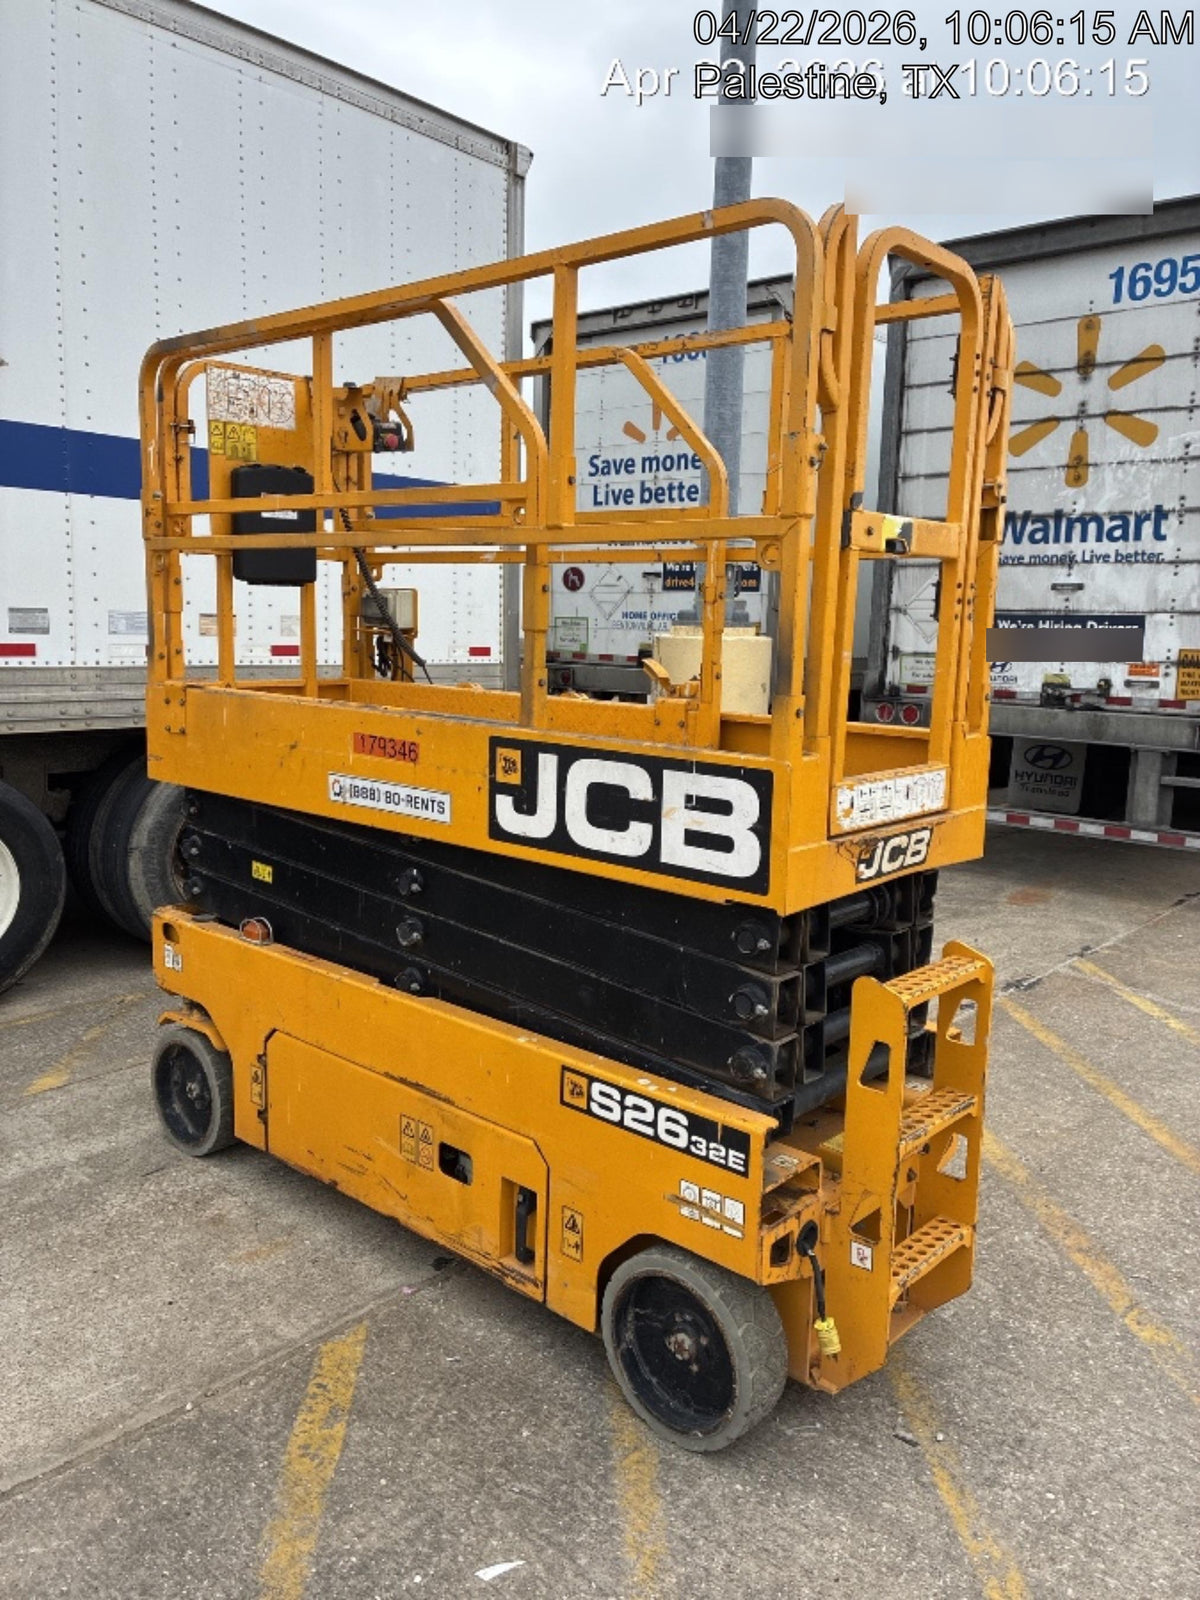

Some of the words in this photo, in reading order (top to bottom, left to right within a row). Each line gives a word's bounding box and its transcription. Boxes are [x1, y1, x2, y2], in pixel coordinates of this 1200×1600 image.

[588, 454, 636, 477] Save
[641, 452, 702, 474] mone
[593, 482, 635, 506] Live
[639, 480, 700, 504] bette
[1001, 504, 1169, 545] Walmart
[1082, 550, 1111, 564] Live
[1114, 549, 1166, 564] better.
[360, 734, 417, 762] 179346
[495, 752, 762, 878] JCB
[857, 829, 932, 879] JCB
[590, 1081, 689, 1149] S26
[689, 1135, 746, 1172] 32E
